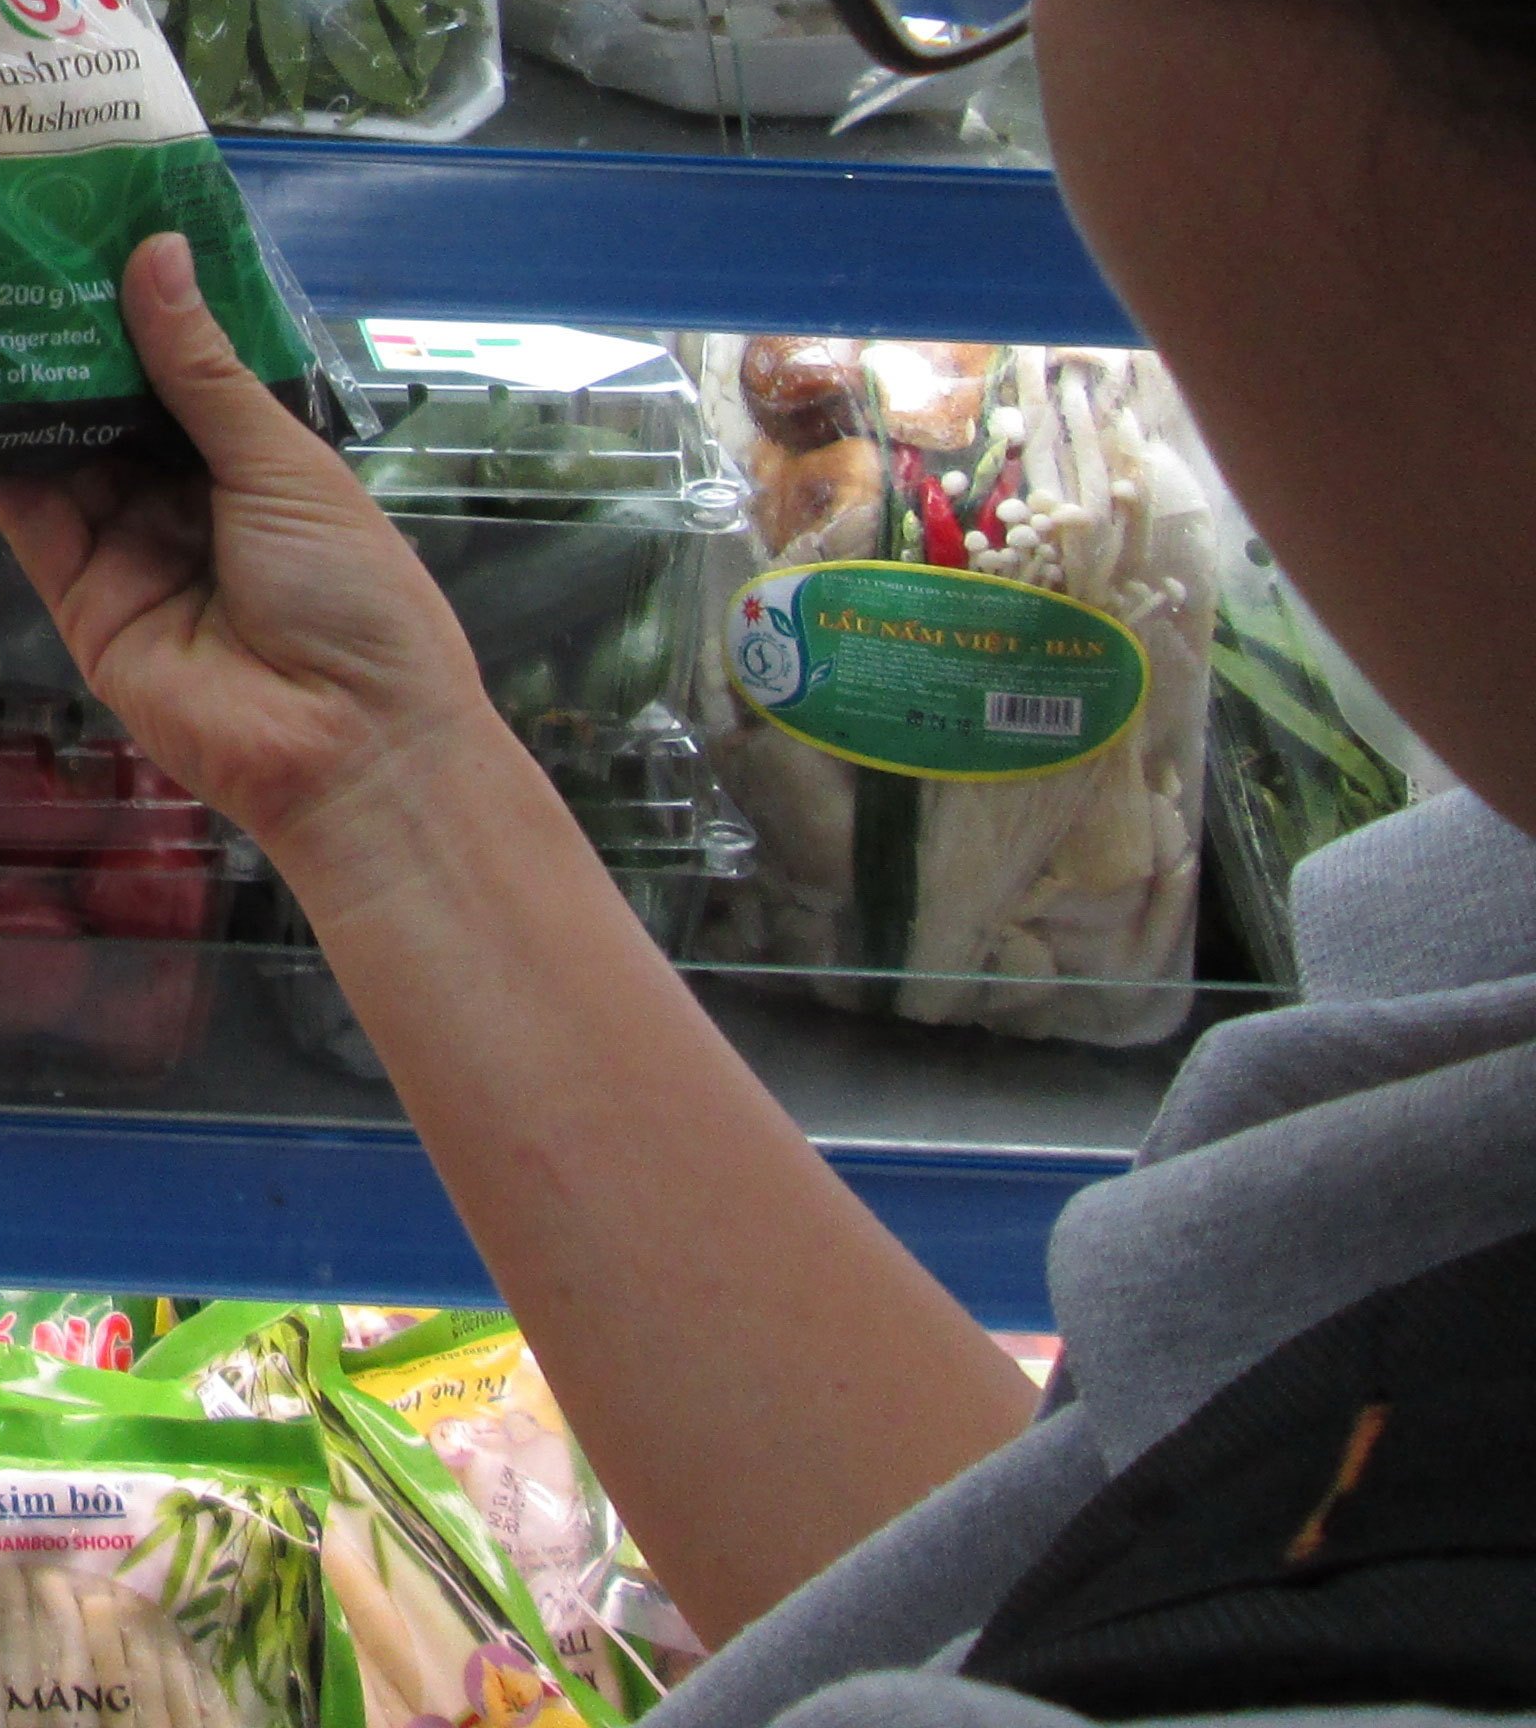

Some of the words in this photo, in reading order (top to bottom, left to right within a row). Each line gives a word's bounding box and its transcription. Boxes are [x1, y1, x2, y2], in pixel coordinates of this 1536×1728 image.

[7, 363, 29, 384] of
[30, 363, 92, 384] Korea
[69, 1484, 126, 1515] bôi
[72, 1533, 135, 1552] SHOOT
